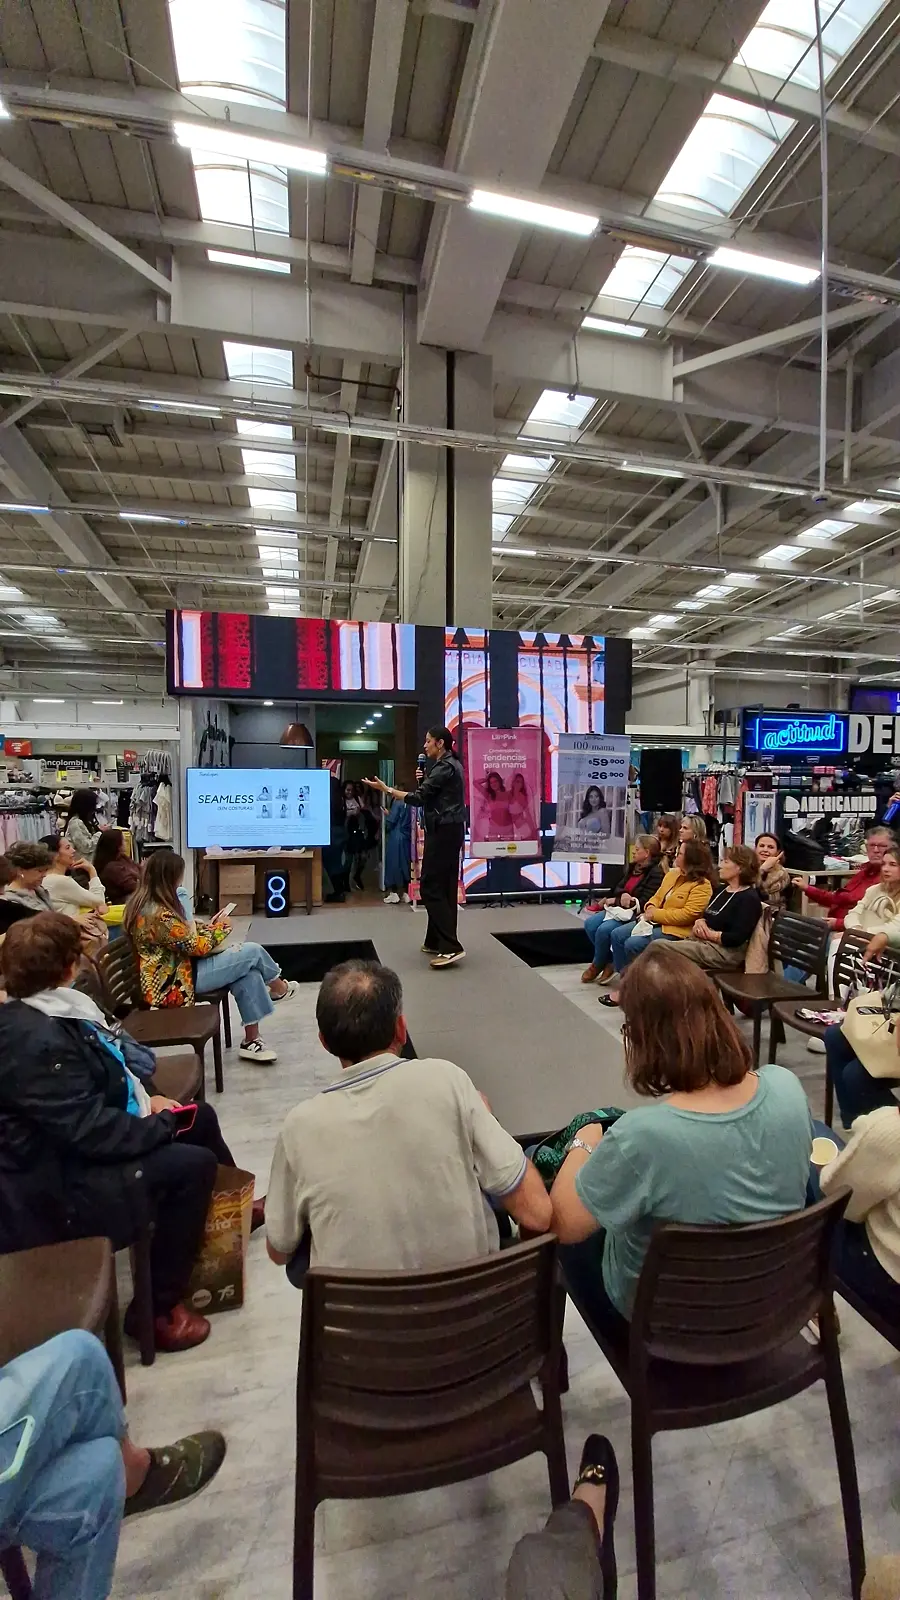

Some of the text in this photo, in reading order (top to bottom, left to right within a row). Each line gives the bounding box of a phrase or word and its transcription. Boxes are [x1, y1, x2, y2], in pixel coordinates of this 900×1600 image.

[764, 714, 836, 749] actitud
[483, 753, 527, 761] Tendencias
[483, 760, 527, 770] para mamá
[198, 794, 254, 804] SEAMLESS
